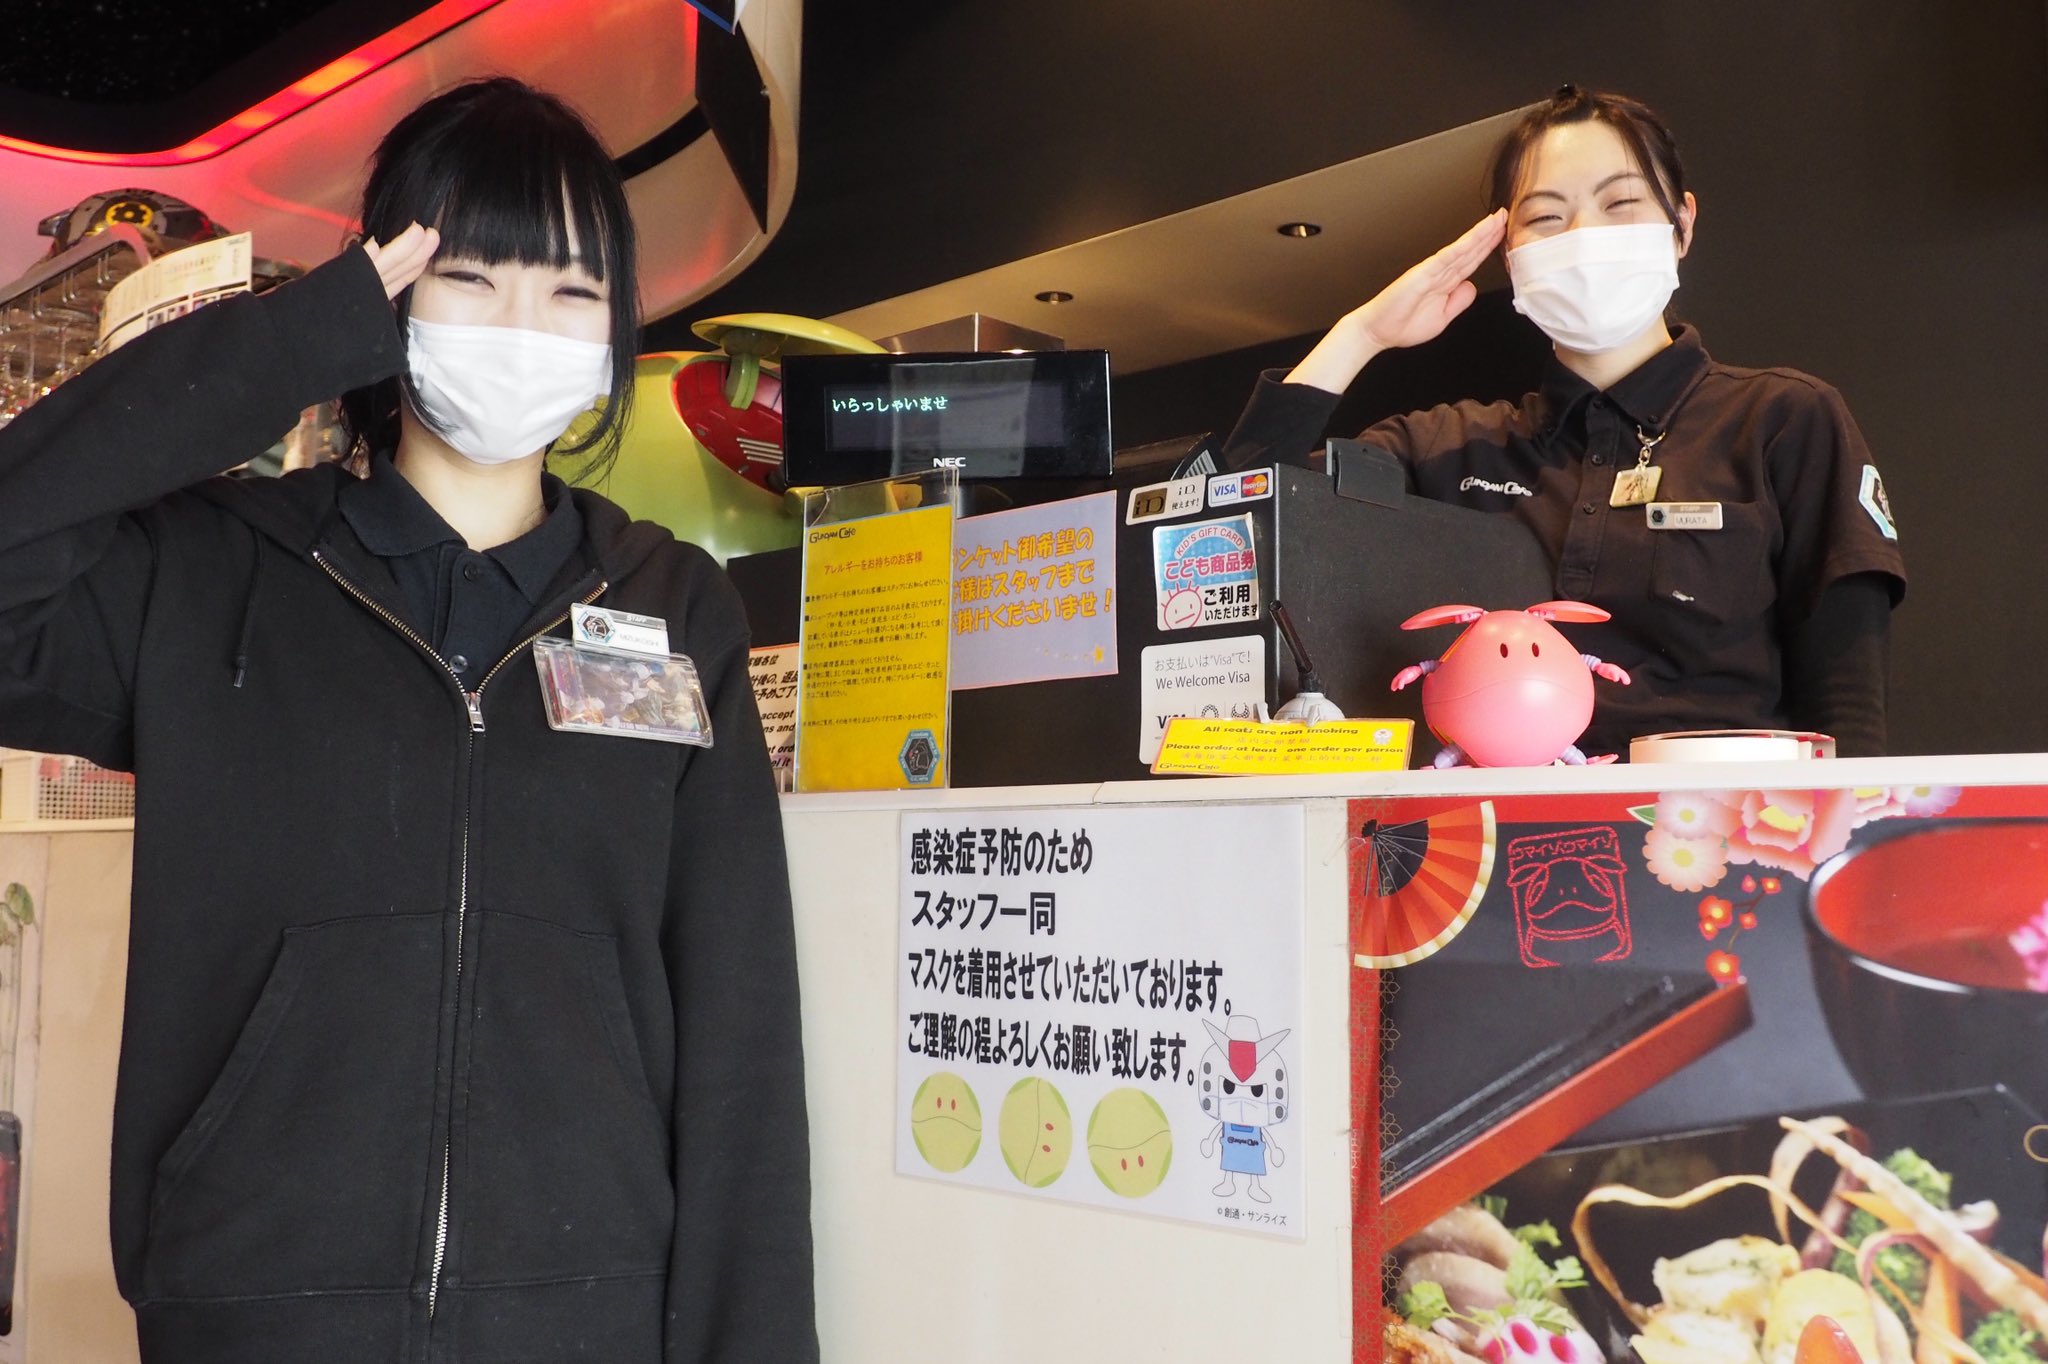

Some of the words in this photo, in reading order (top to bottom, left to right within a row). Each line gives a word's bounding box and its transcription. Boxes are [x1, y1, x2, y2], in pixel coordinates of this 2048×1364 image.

[832, 396, 948, 413] いらっしゃいませ
[933, 457, 966, 468] NEC
[1178, 483, 1196, 496] iD
[1214, 483, 1237, 497] VISA
[1135, 496, 1164, 515] iD
[954, 527, 1094, 571] ンケット御希望の
[1176, 534, 1196, 556] KID'S
[1198, 527, 1218, 538] GIFT
[1220, 528, 1243, 547] CARD
[1165, 550, 1255, 580] こども商品券
[953, 560, 1095, 604] 様はスタッフまで
[1204, 584, 1250, 606] ご利用
[952, 588, 1112, 636] 掛けくださいませ！
[1156, 677, 1173, 690] We
[1175, 674, 1226, 688] Welcome
[1228, 671, 1250, 683] Visa
[761, 710, 794, 721] accept
[777, 723, 796, 732] and
[1307, 727, 1359, 736] smoking
[910, 828, 1093, 876] 感染症予防のため
[911, 890, 1056, 936] スタッフ一同
[908, 948, 1231, 1016] マスクを着用させていただいております。
[907, 1012, 1194, 1086] ご理解の程よろしくお願い致します。
